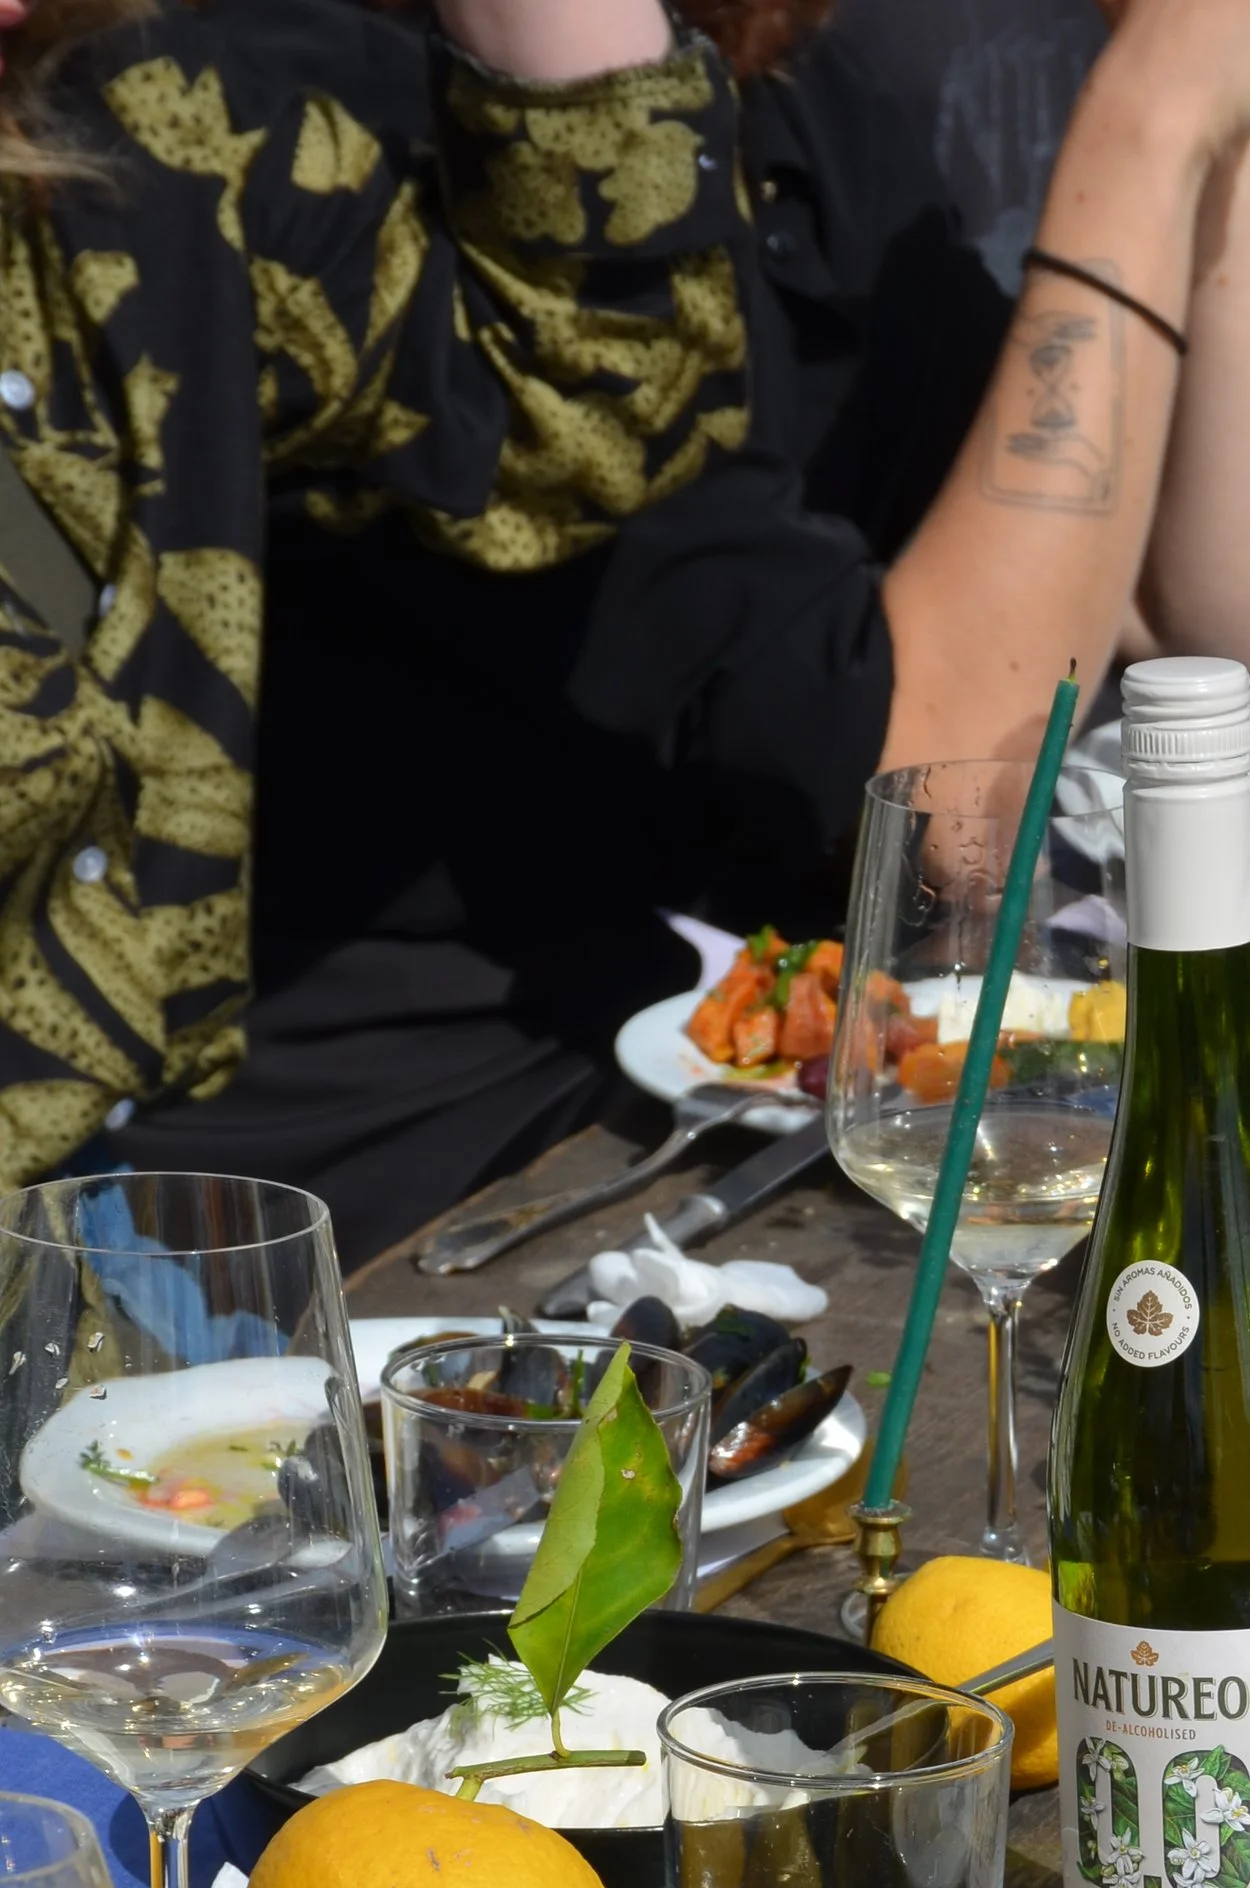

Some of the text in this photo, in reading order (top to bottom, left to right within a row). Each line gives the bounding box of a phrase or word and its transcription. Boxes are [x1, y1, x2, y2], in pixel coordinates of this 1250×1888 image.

[1114, 1267, 1193, 1310] SIN AROMAS AÑADIDOS
[1112, 1322, 1190, 1360] NO ADDED FLAVOURS
[1072, 1656, 1250, 1721] NATUREO
[1105, 1719, 1197, 1741] DE-ALCOHOLISED
